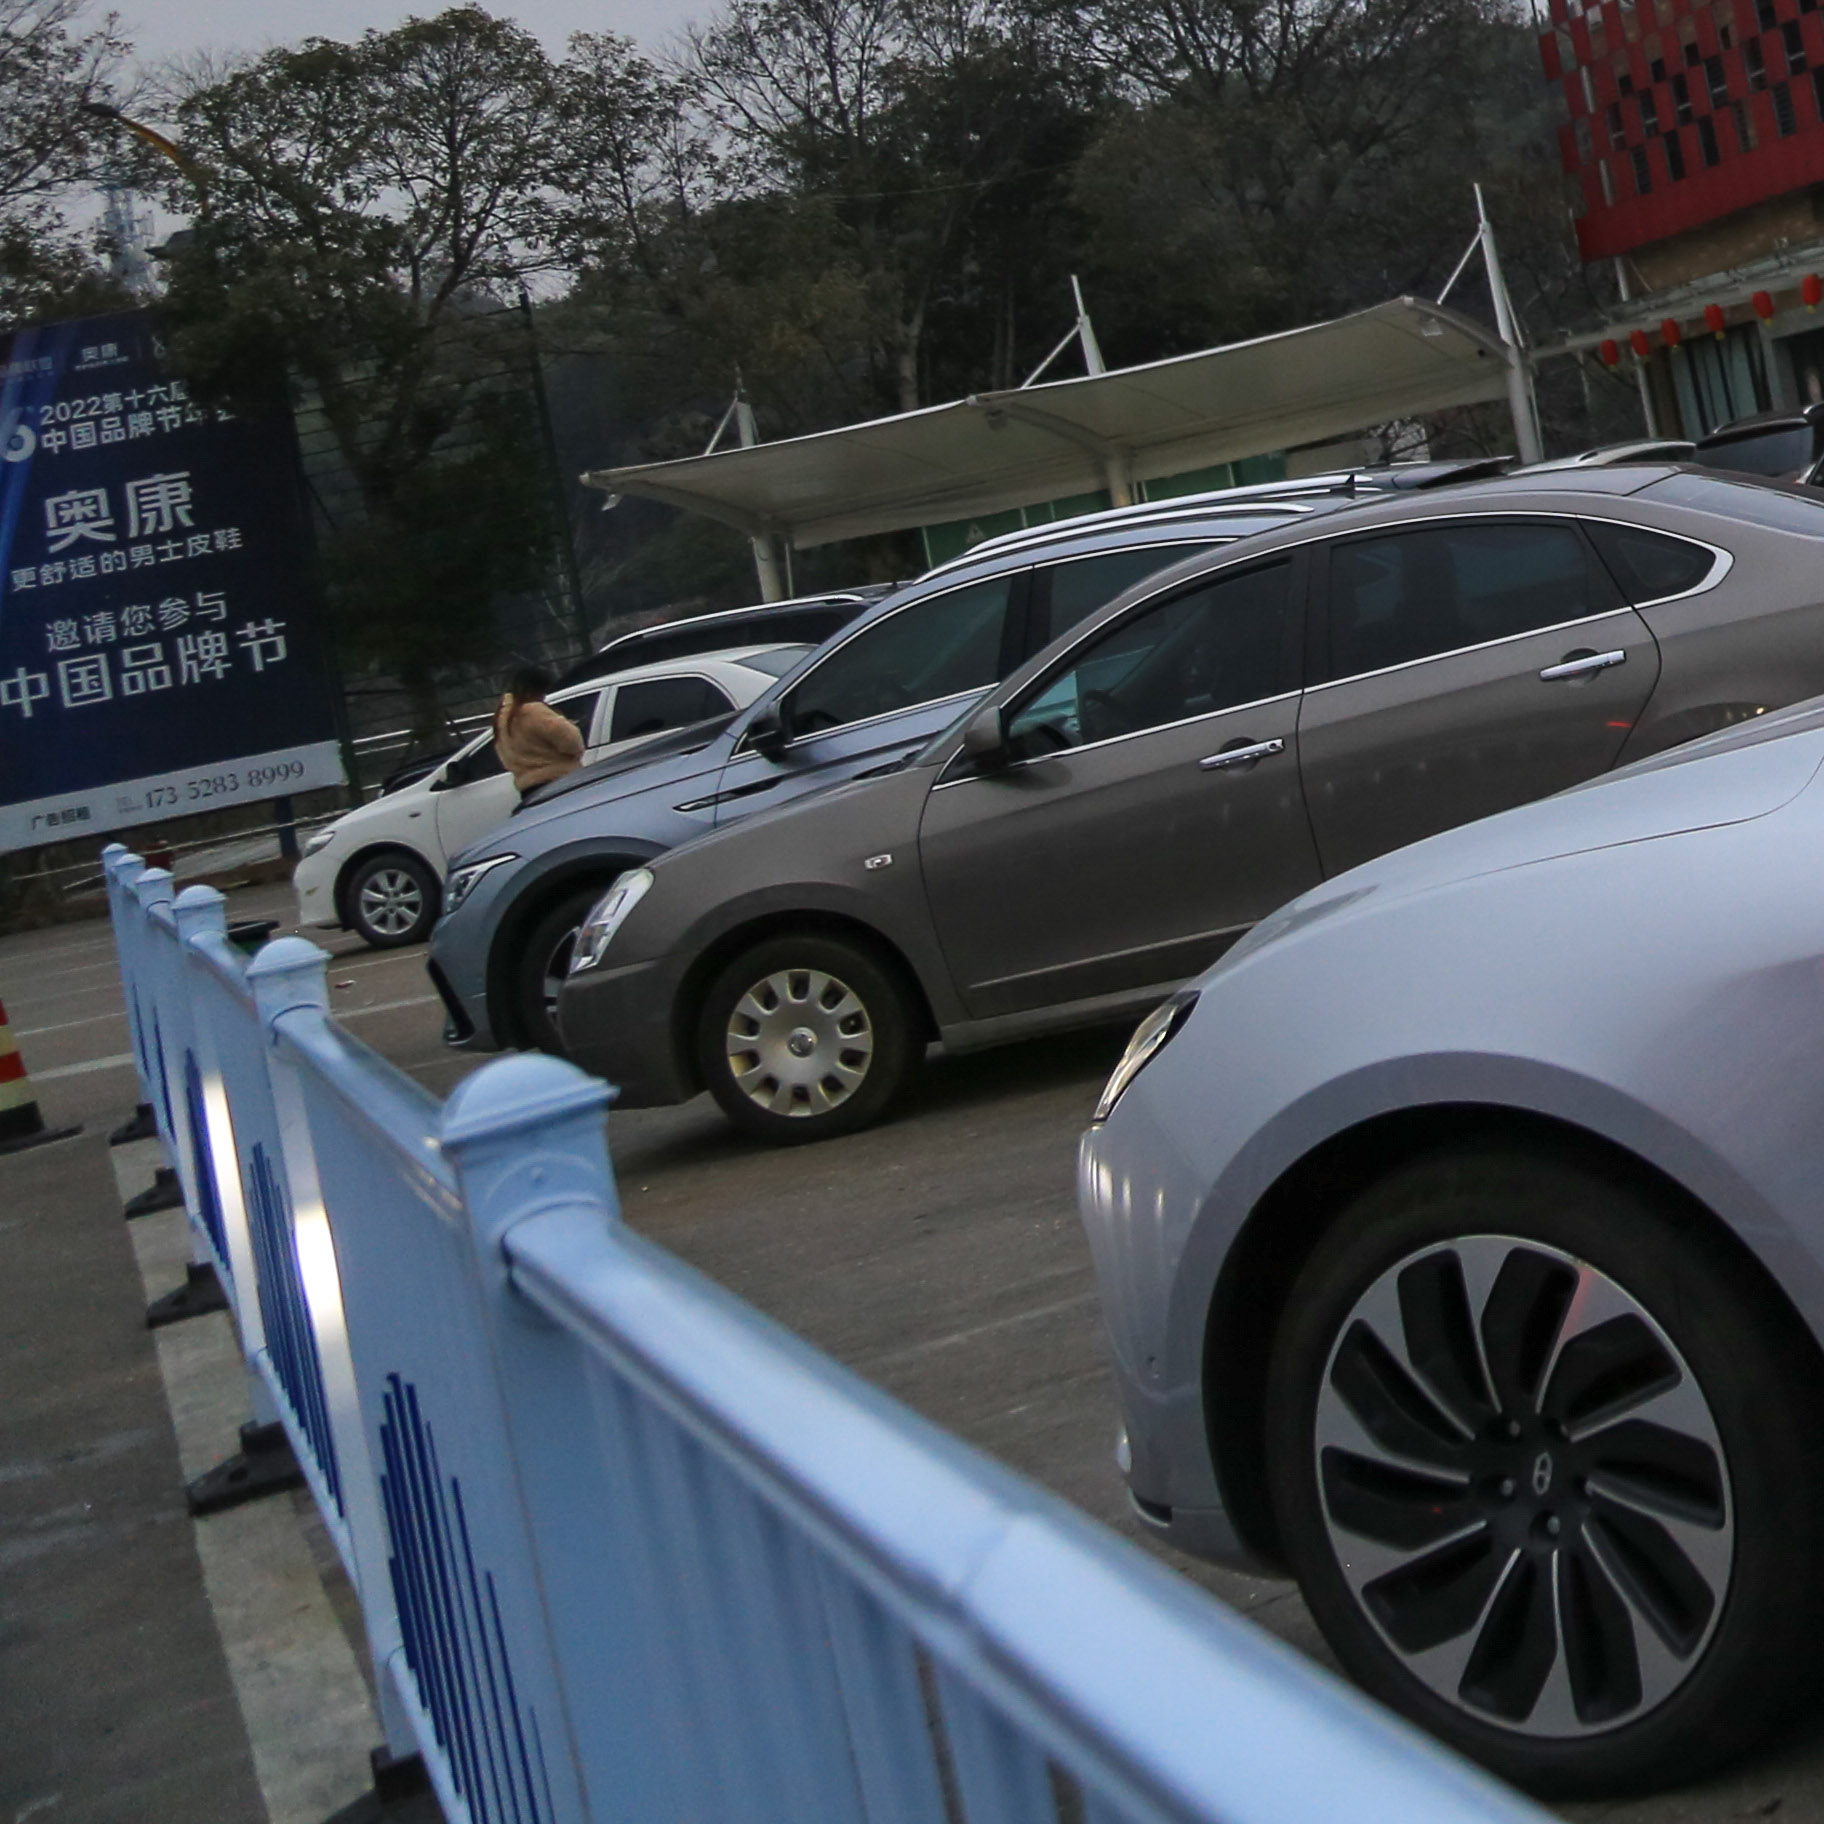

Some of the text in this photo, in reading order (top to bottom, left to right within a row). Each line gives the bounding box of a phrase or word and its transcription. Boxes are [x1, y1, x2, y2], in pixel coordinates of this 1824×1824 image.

[44, 470, 195, 555] 奥康
[11, 526, 243, 592] 更舒适的男士皮鞋
[45, 591, 228, 655] 邀请您参与
[0, 617, 288, 719] 中国品牌节
[144, 786, 179, 810] 173
[187, 773, 240, 801] 5283
[247, 760, 305, 789] 8999
